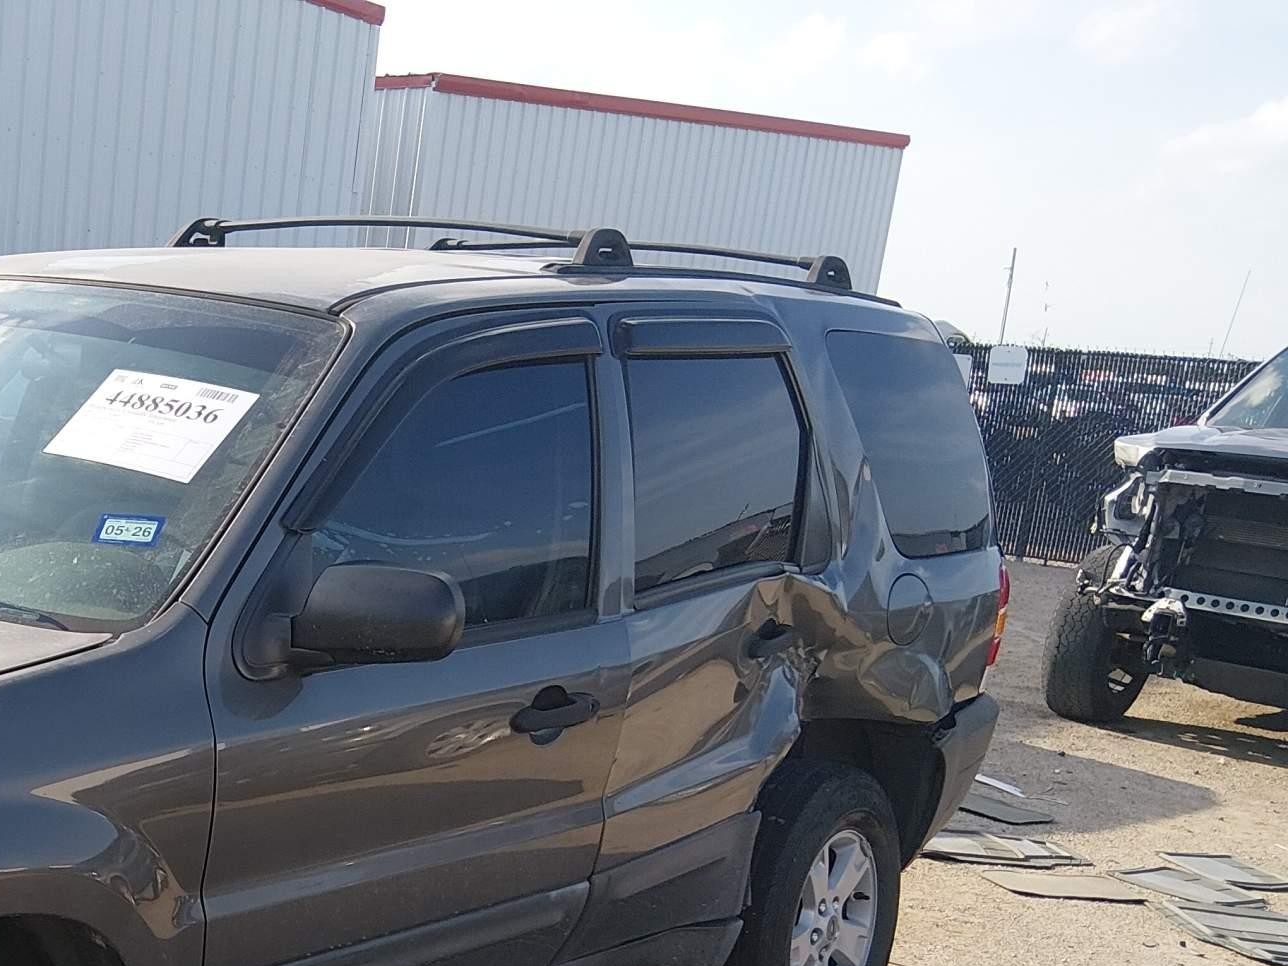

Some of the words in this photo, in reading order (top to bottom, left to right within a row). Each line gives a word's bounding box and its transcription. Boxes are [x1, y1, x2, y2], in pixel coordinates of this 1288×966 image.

[105, 390, 225, 424] 44885036
[104, 524, 126, 536] 05
[131, 526, 153, 538] 26
